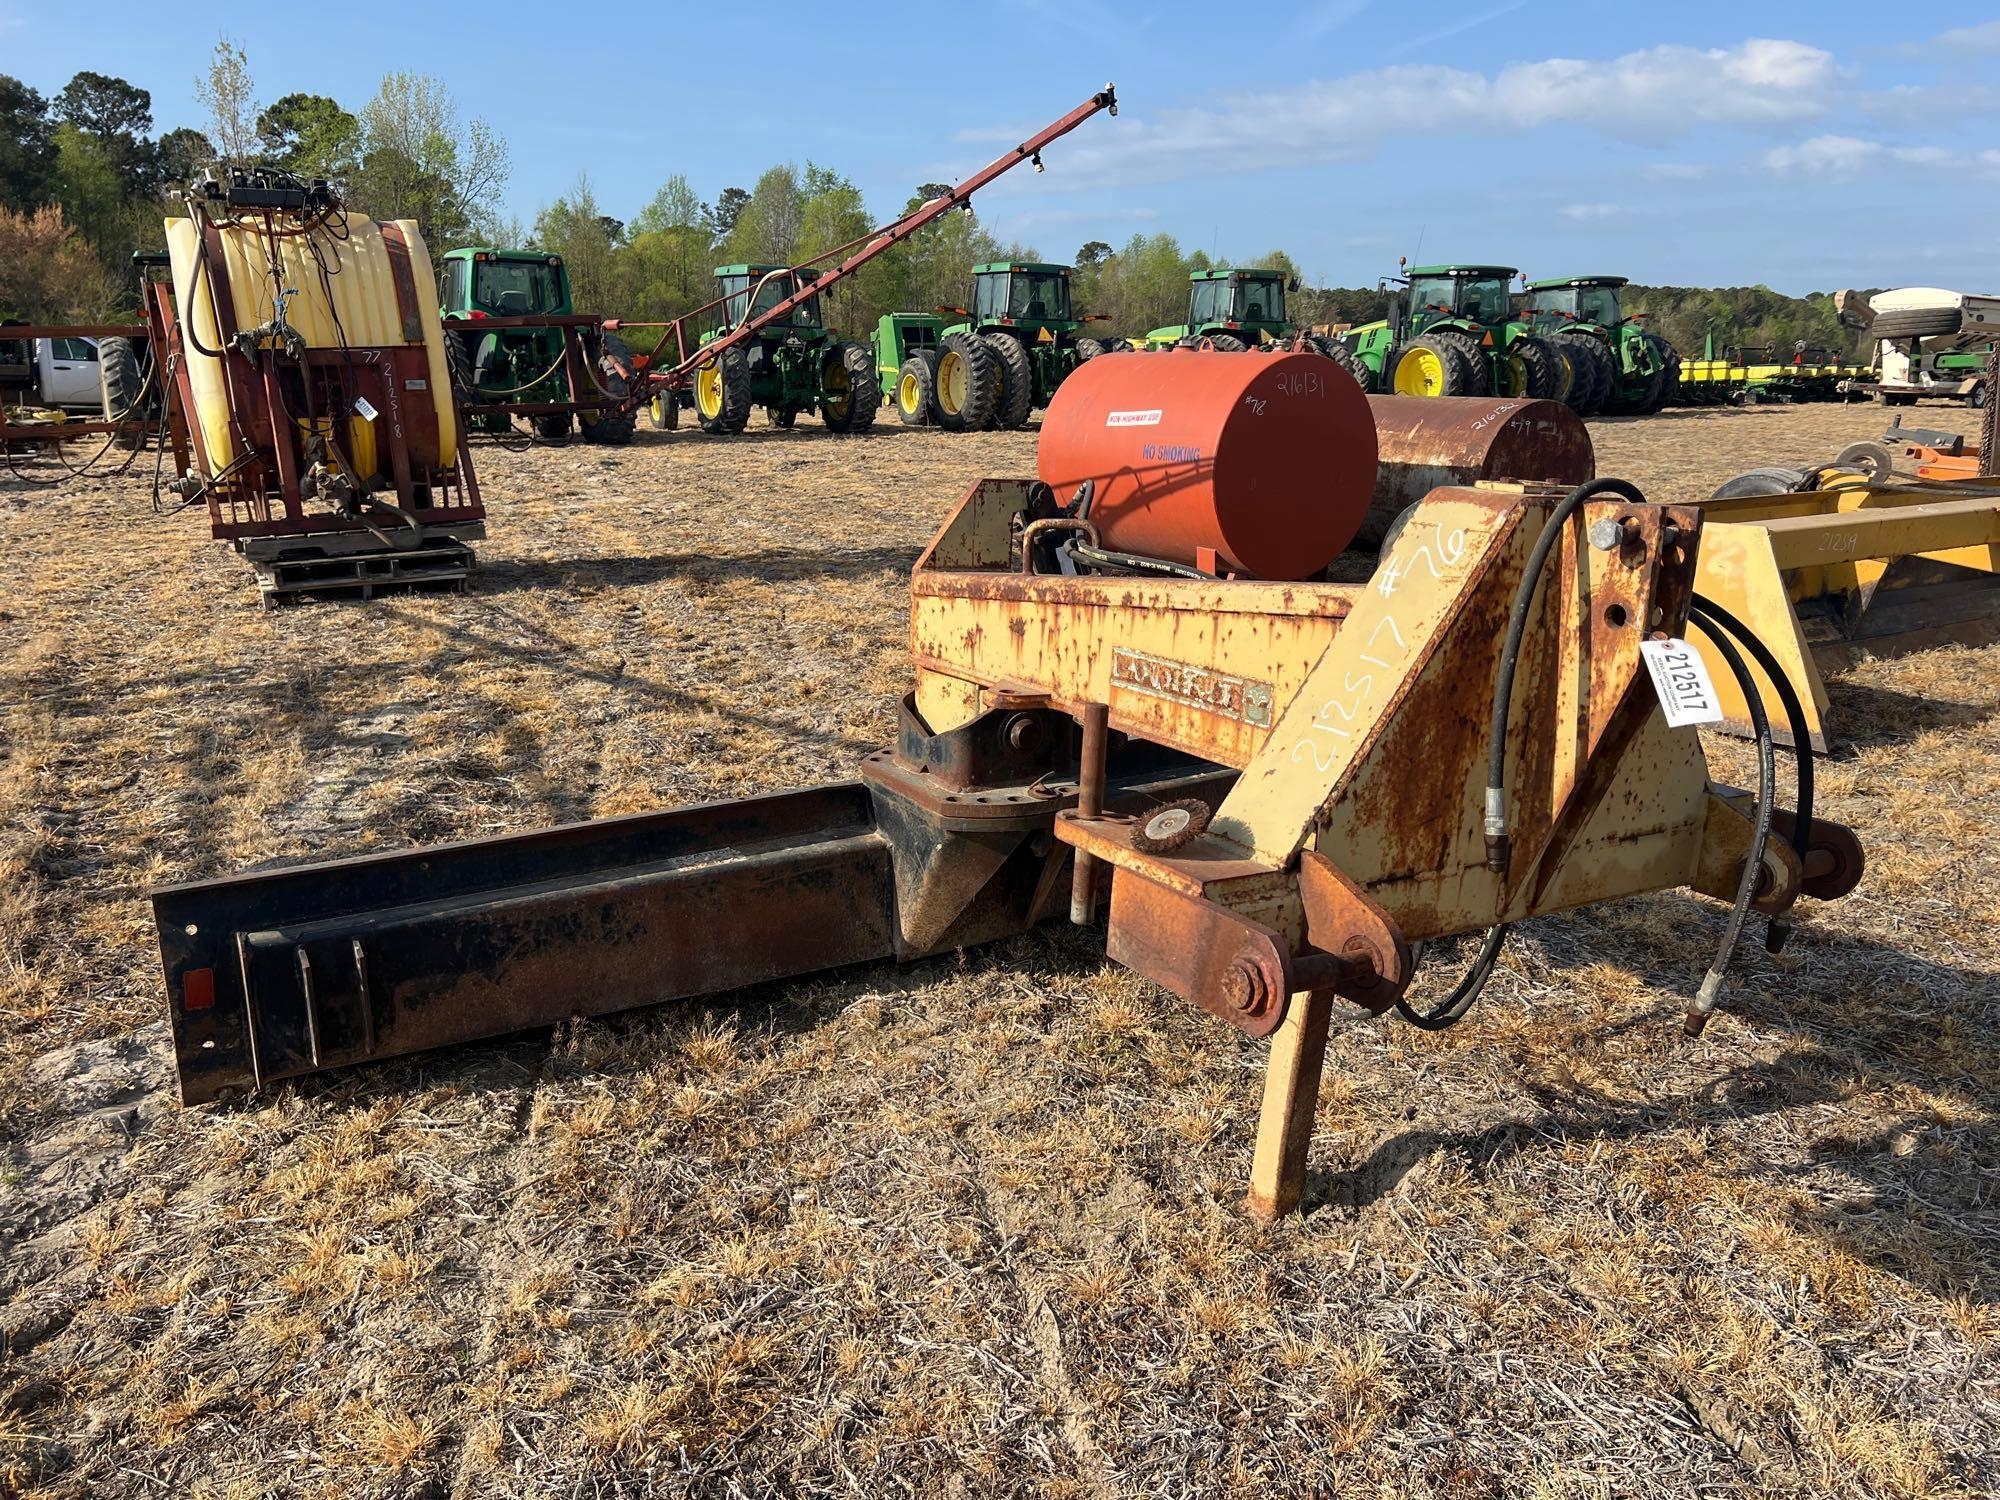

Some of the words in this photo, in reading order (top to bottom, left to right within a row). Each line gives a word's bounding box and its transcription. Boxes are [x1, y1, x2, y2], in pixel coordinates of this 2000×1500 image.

[362, 350, 381, 363] 77
[1276, 371, 1325, 398] 216131
[384, 362, 402, 439] 212518
[1246, 396, 1267, 416] #78
[1109, 413, 1147, 423] NON-HIGHWAY
[1148, 412, 1160, 421] USE
[1471, 402, 1520, 431] 216132
[1142, 444, 1155, 460] NO
[1157, 446, 1200, 462] SMOKING
[1377, 522, 1467, 599] #76
[1290, 614, 1407, 773] 212517
[1664, 653, 1709, 710] 212517
